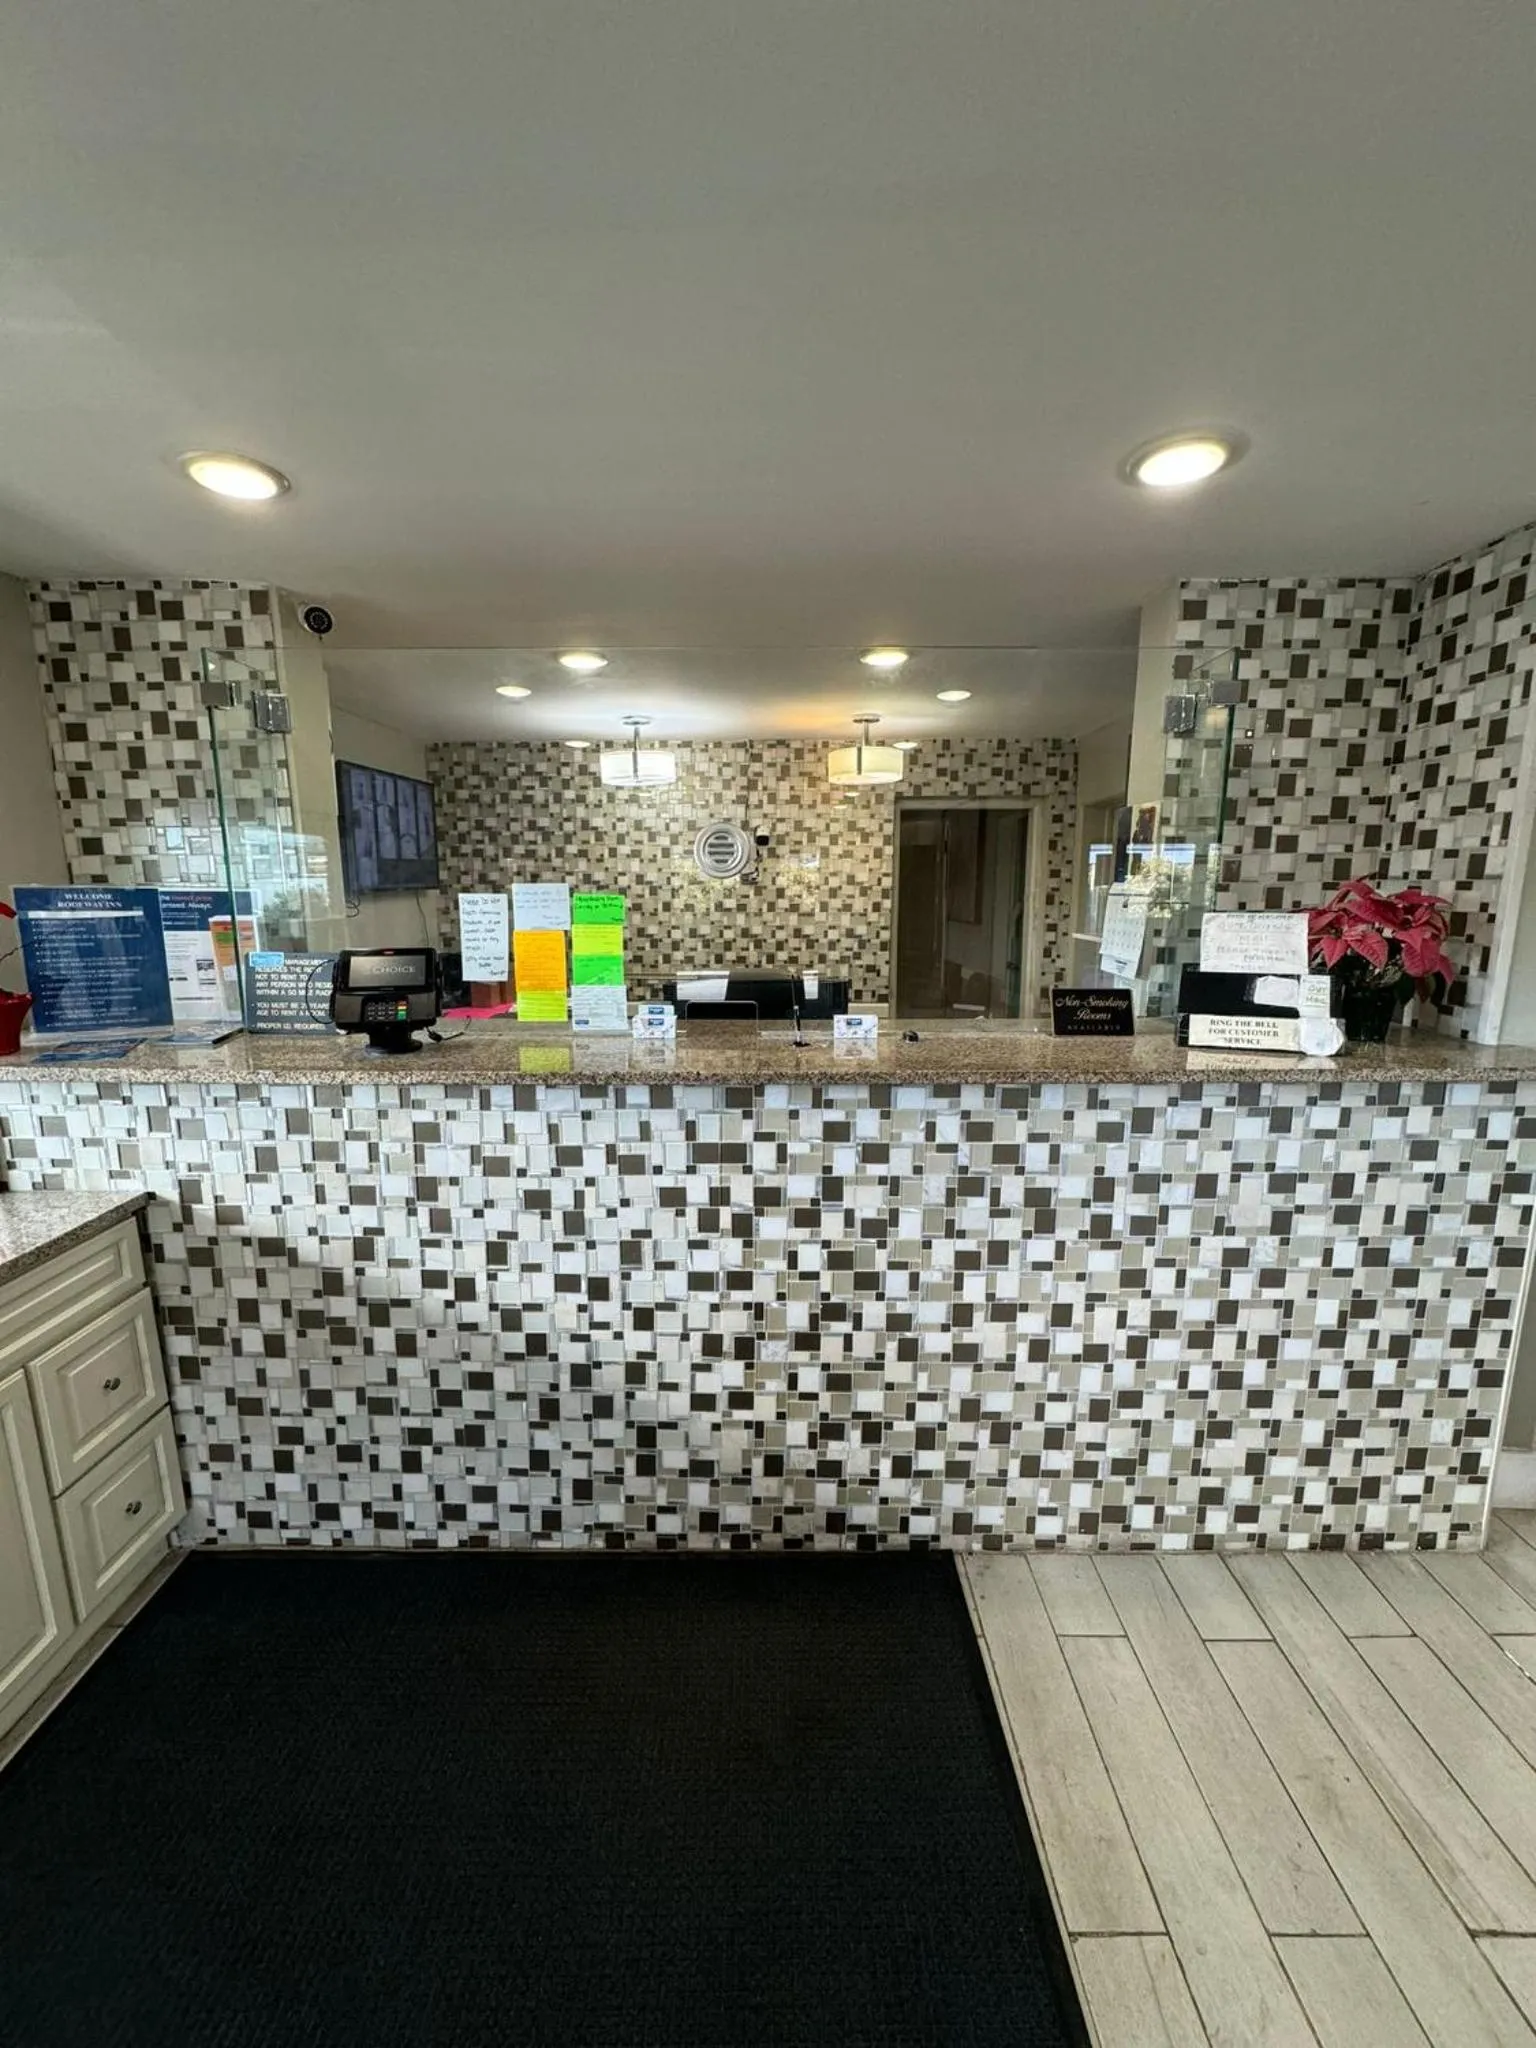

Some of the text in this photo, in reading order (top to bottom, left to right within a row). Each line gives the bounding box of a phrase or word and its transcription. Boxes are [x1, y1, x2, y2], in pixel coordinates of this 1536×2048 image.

[372, 965, 416, 973] CHOICE
[1055, 995, 1129, 1010] Non-Smoking
[1073, 1008, 1111, 1020] Rooms
[1255, 1020, 1279, 1029] BELL
[1228, 1028, 1279, 1038] CUSTOMER
[1224, 1037, 1260, 1046] SERVICE
